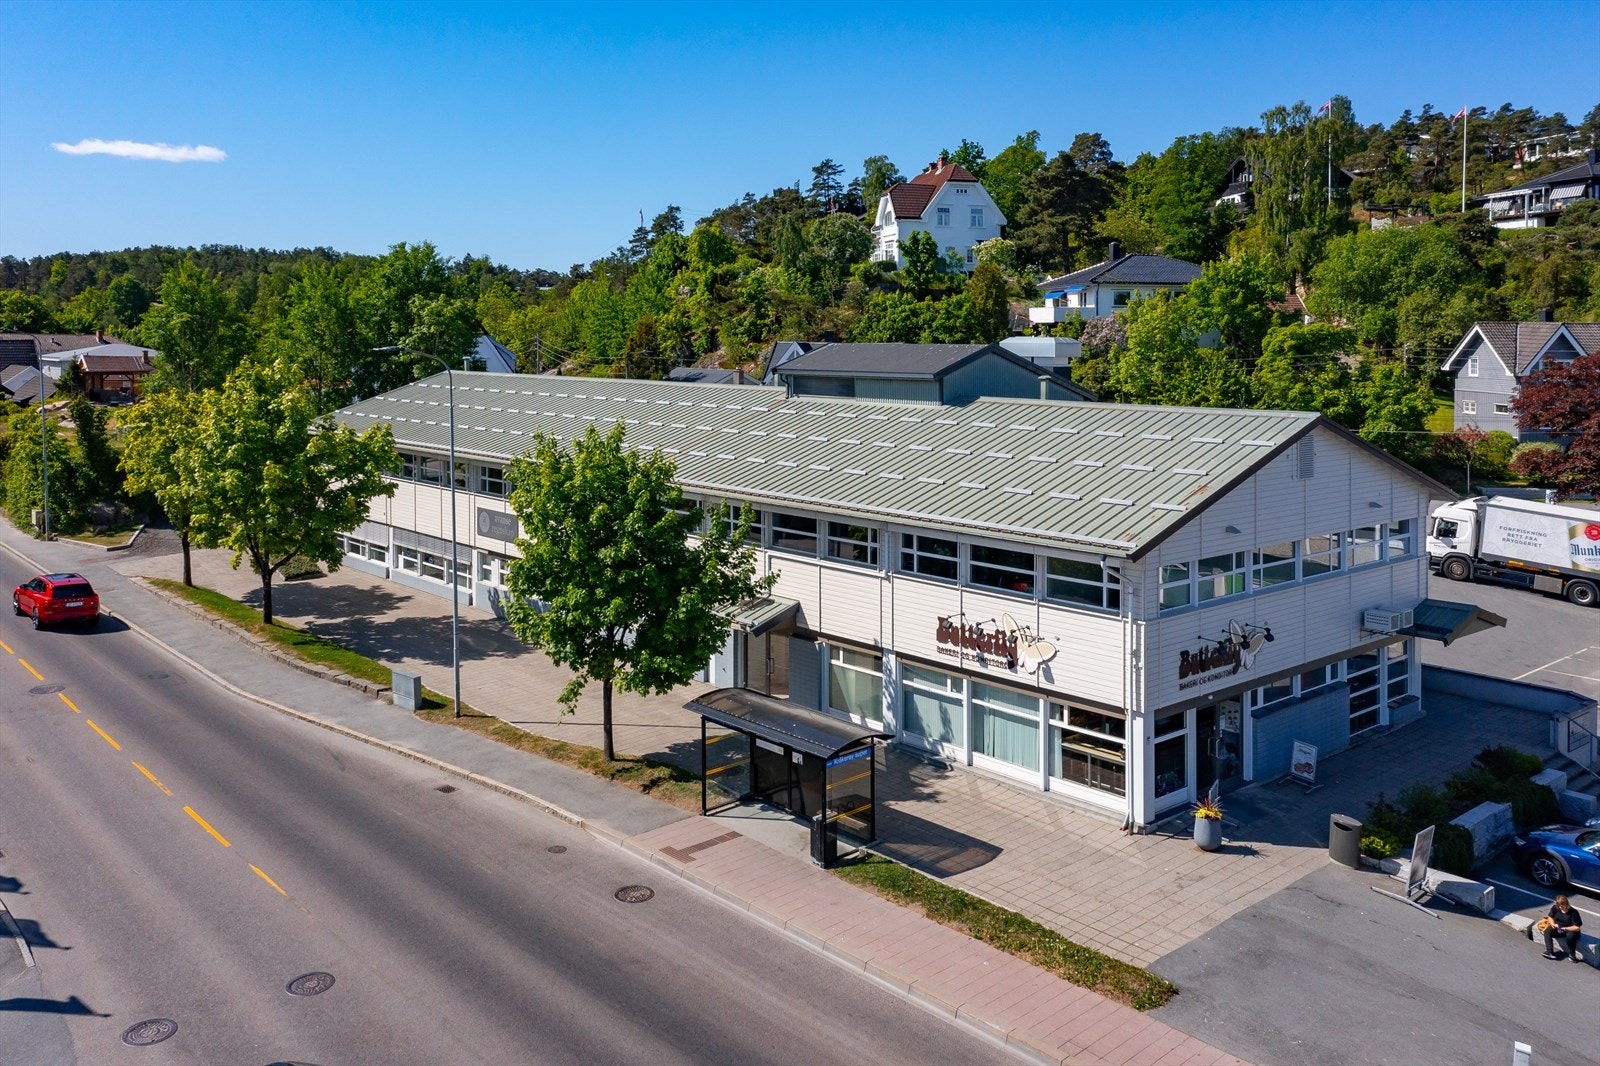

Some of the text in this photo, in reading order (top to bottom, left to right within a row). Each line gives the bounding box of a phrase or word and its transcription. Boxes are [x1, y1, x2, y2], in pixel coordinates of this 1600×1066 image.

[1499, 525, 1547, 537] FORFRISKNING
[1502, 537, 1542, 547] BRYGGERIET
[936, 616, 1018, 669] Butterfly
[936, 645, 960, 658] BAKERI
[960, 651, 970, 659] OG
[1179, 669, 1233, 691] BAKERI OG KONDITOR
